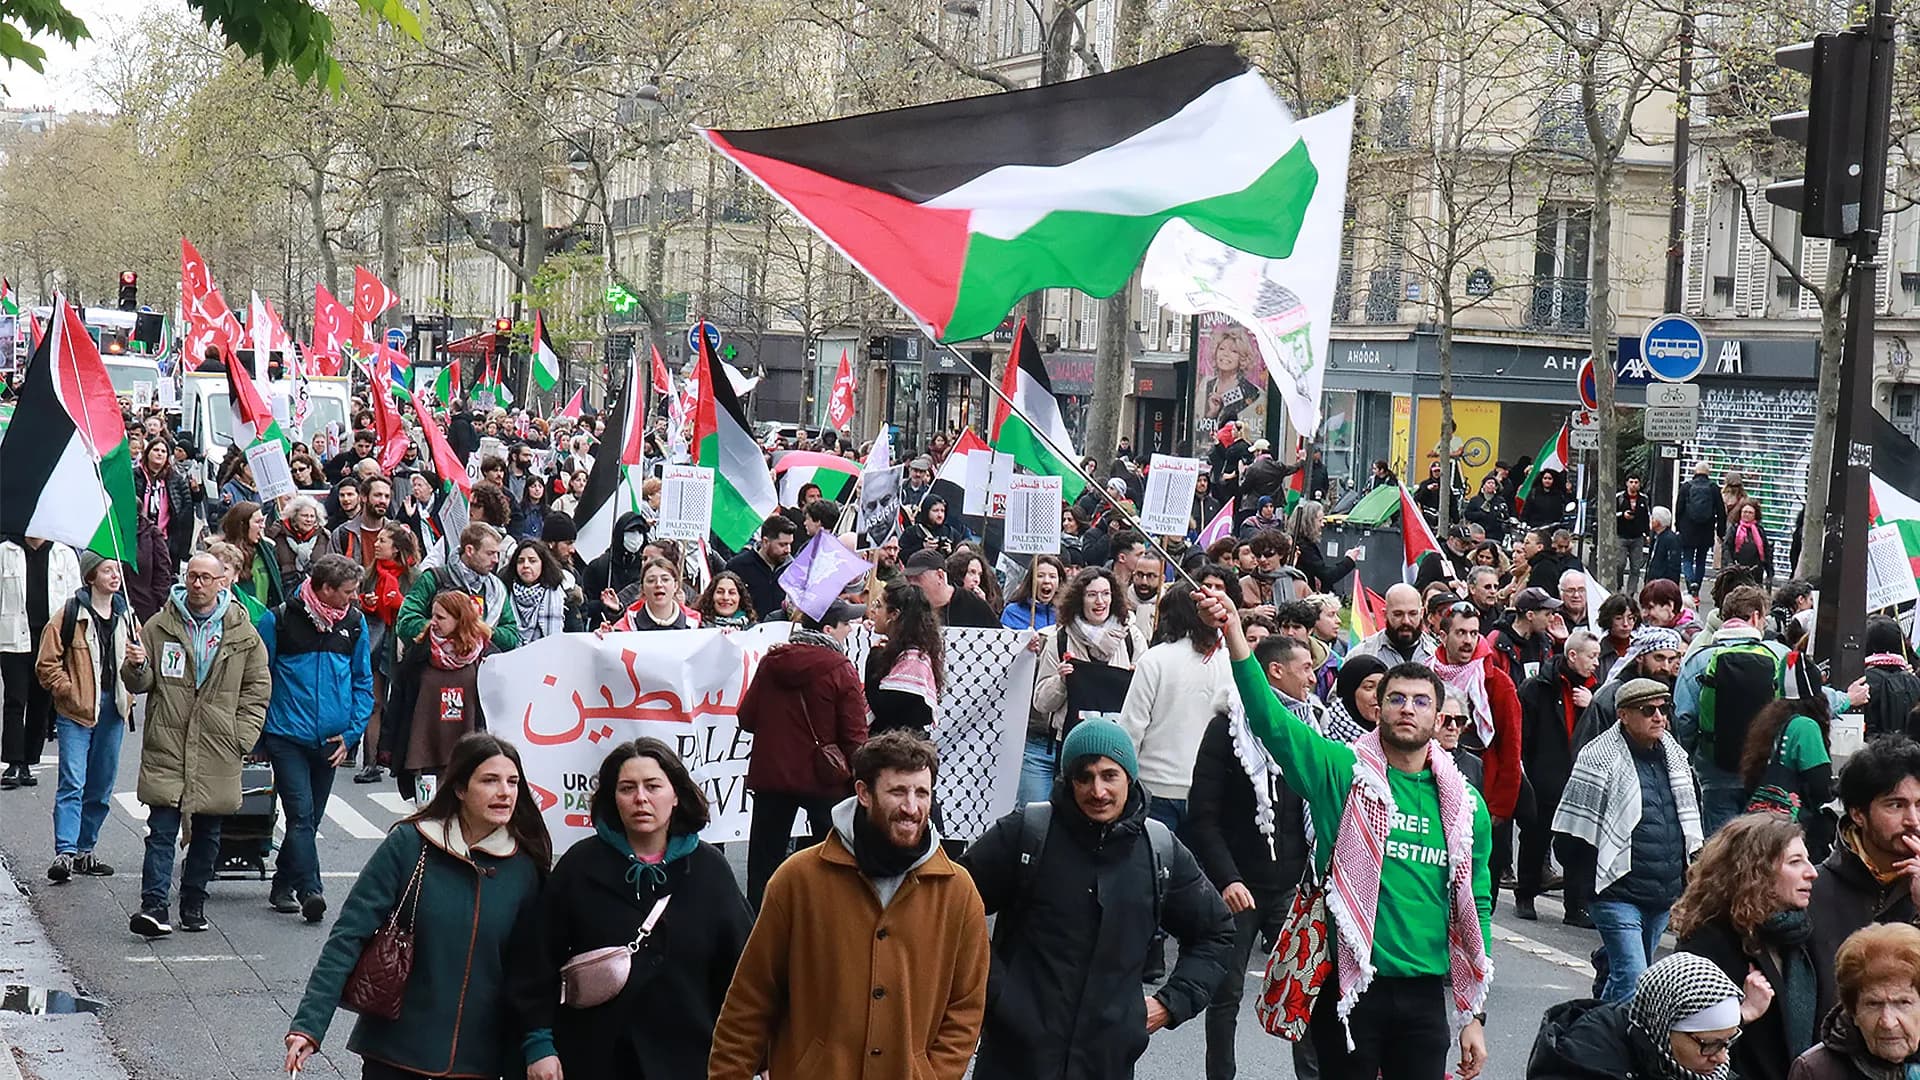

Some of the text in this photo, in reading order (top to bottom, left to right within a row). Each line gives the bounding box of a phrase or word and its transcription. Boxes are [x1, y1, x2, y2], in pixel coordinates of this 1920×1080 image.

[1347, 350, 1380, 364] AHOOCA
[1715, 340, 1743, 374] AXA
[865, 496, 899, 528] ASCISTE
[666, 522, 704, 531] PALESTINE
[672, 529, 695, 537] VIVRA
[1012, 535, 1054, 543] PALESTINE
[1019, 543, 1044, 551] VIVRA
[675, 725, 755, 772] PALE
[1386, 840, 1448, 867] ESTINE
